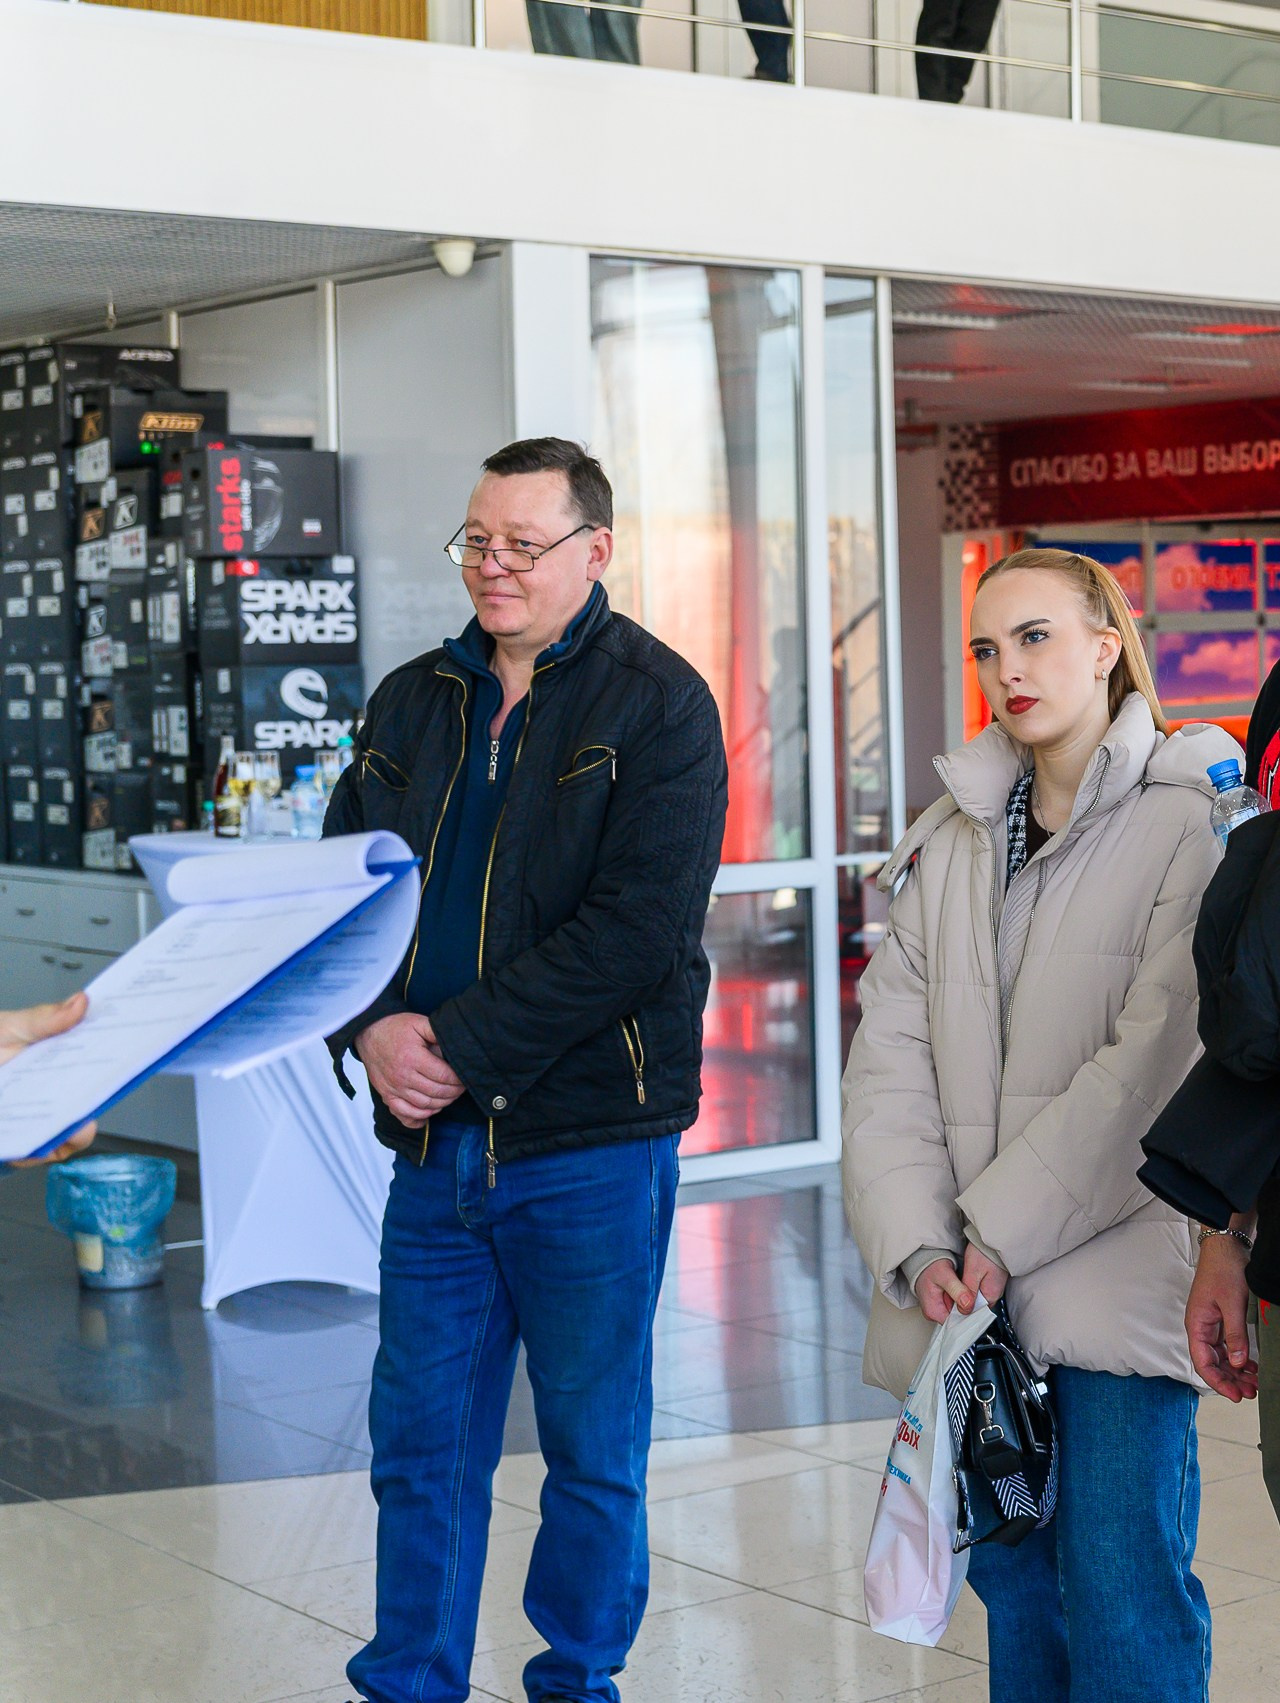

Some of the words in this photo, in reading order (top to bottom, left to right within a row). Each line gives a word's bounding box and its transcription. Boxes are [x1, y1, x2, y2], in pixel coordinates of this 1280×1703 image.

[1010, 453, 1108, 488] СПАСИБО
[1113, 451, 1141, 482] ЗА
[1146, 447, 1198, 478] ВАШ
[215, 458, 244, 551] starks
[240, 580, 355, 612] SPARX
[243, 612, 357, 644] SPARX
[254, 719, 354, 749] SPARX
